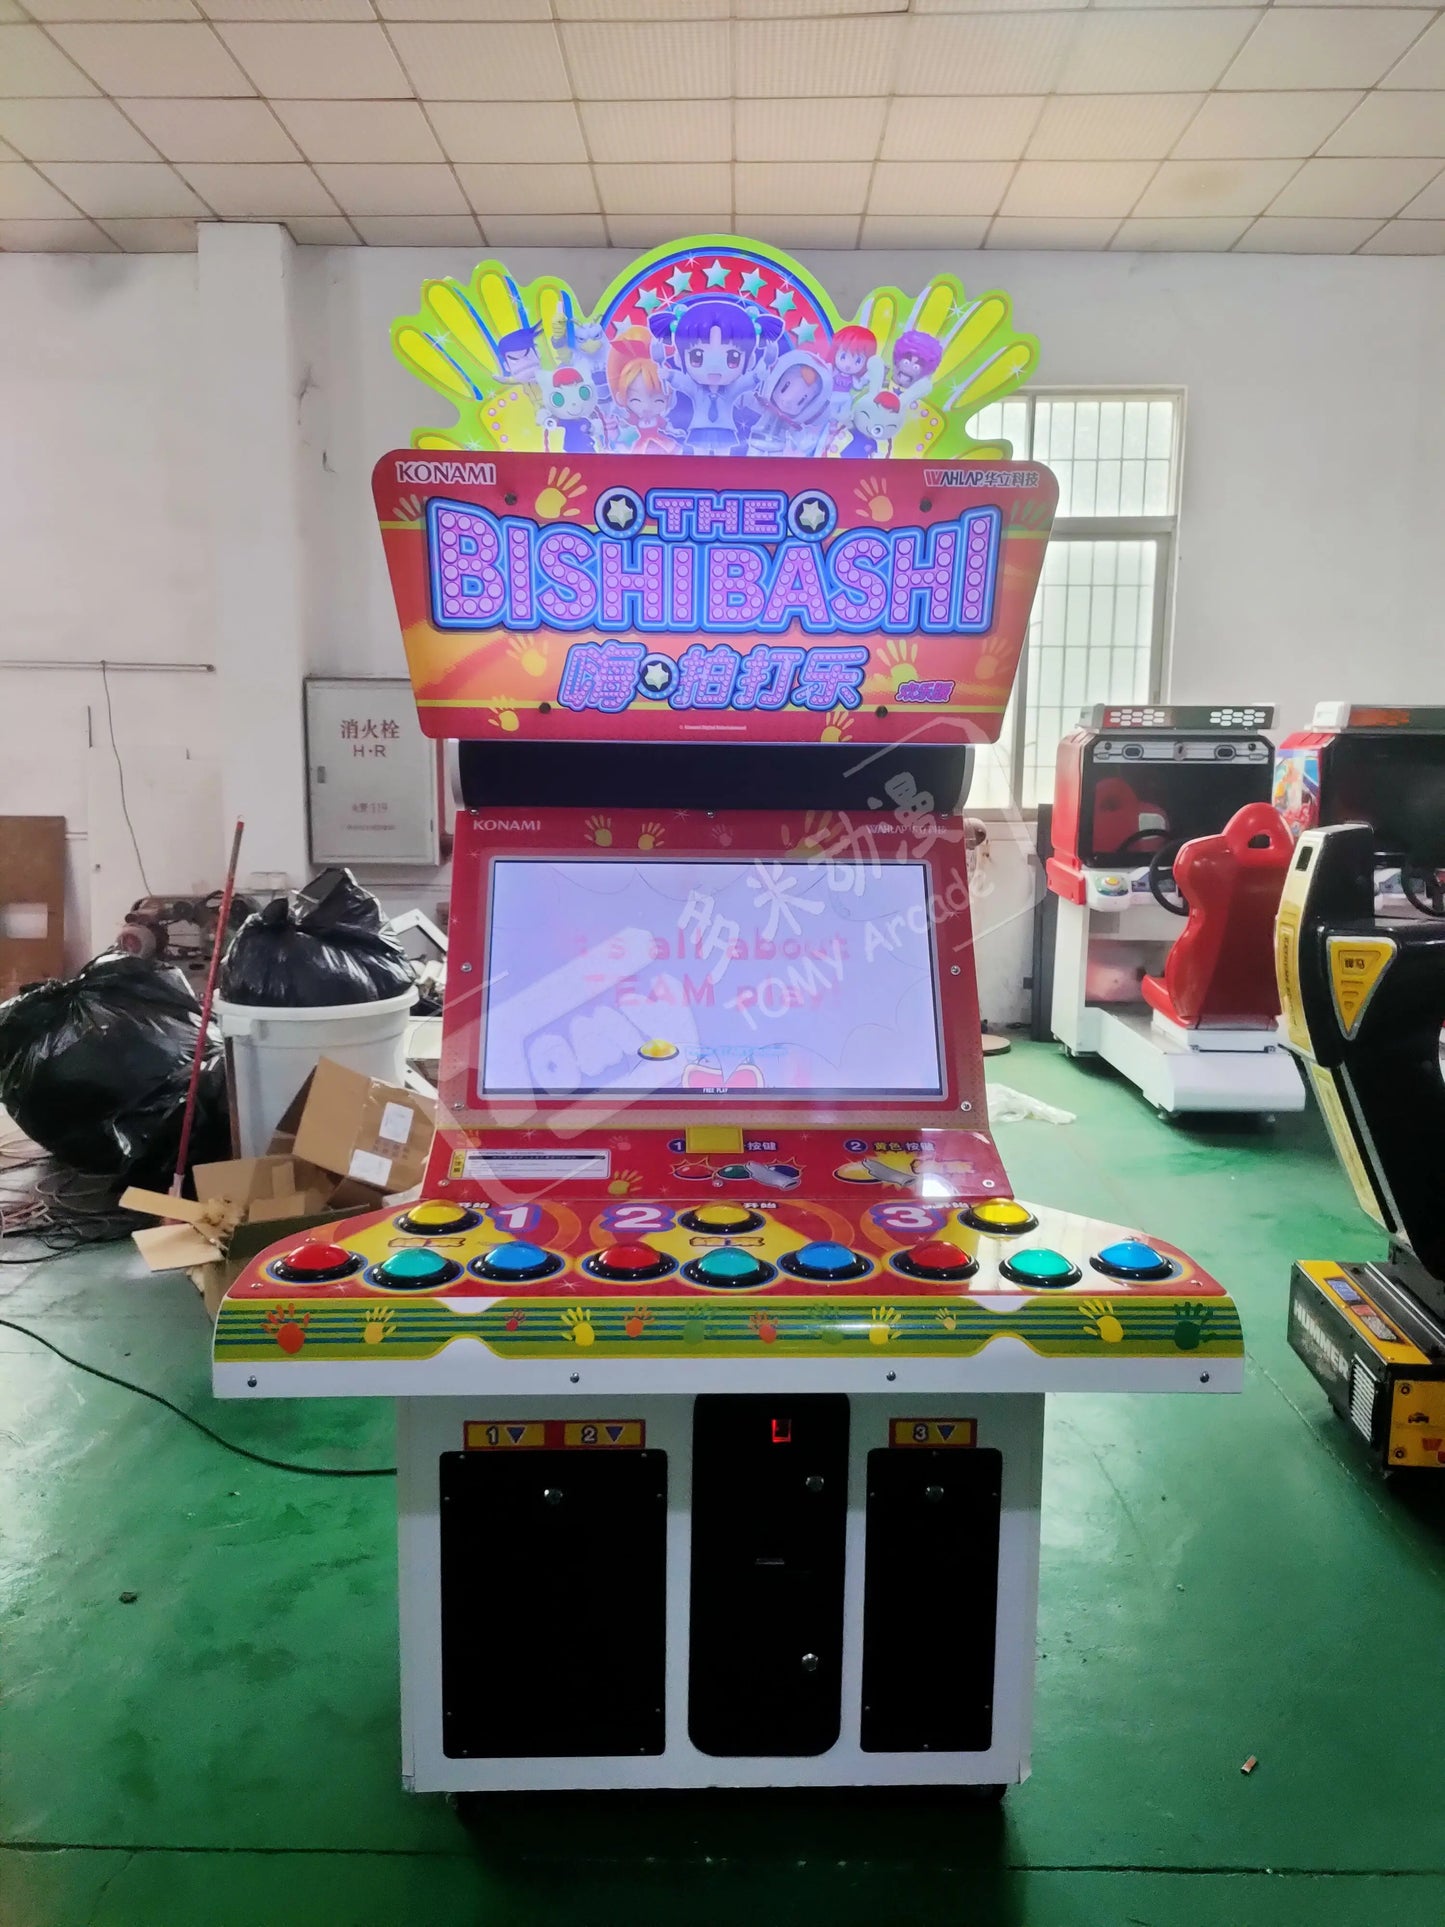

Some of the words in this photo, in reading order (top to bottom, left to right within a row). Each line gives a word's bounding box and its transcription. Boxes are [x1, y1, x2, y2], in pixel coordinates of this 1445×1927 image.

[397, 463, 496, 484] KONAMI
[985, 471, 1039, 488] 华立科技
[650, 494, 785, 539] THE
[340, 719, 400, 739] 消火栓
[473, 819, 542, 832] KONAMI
[674, 1140, 684, 1152] 1
[850, 1140, 860, 1152] 2
[499, 1205, 529, 1229] 1
[614, 1206, 662, 1229] 2
[876, 1205, 934, 1229] 3
[487, 1427, 498, 1443] 1
[582, 1426, 597, 1443] 2
[914, 1424, 927, 1442] 3
